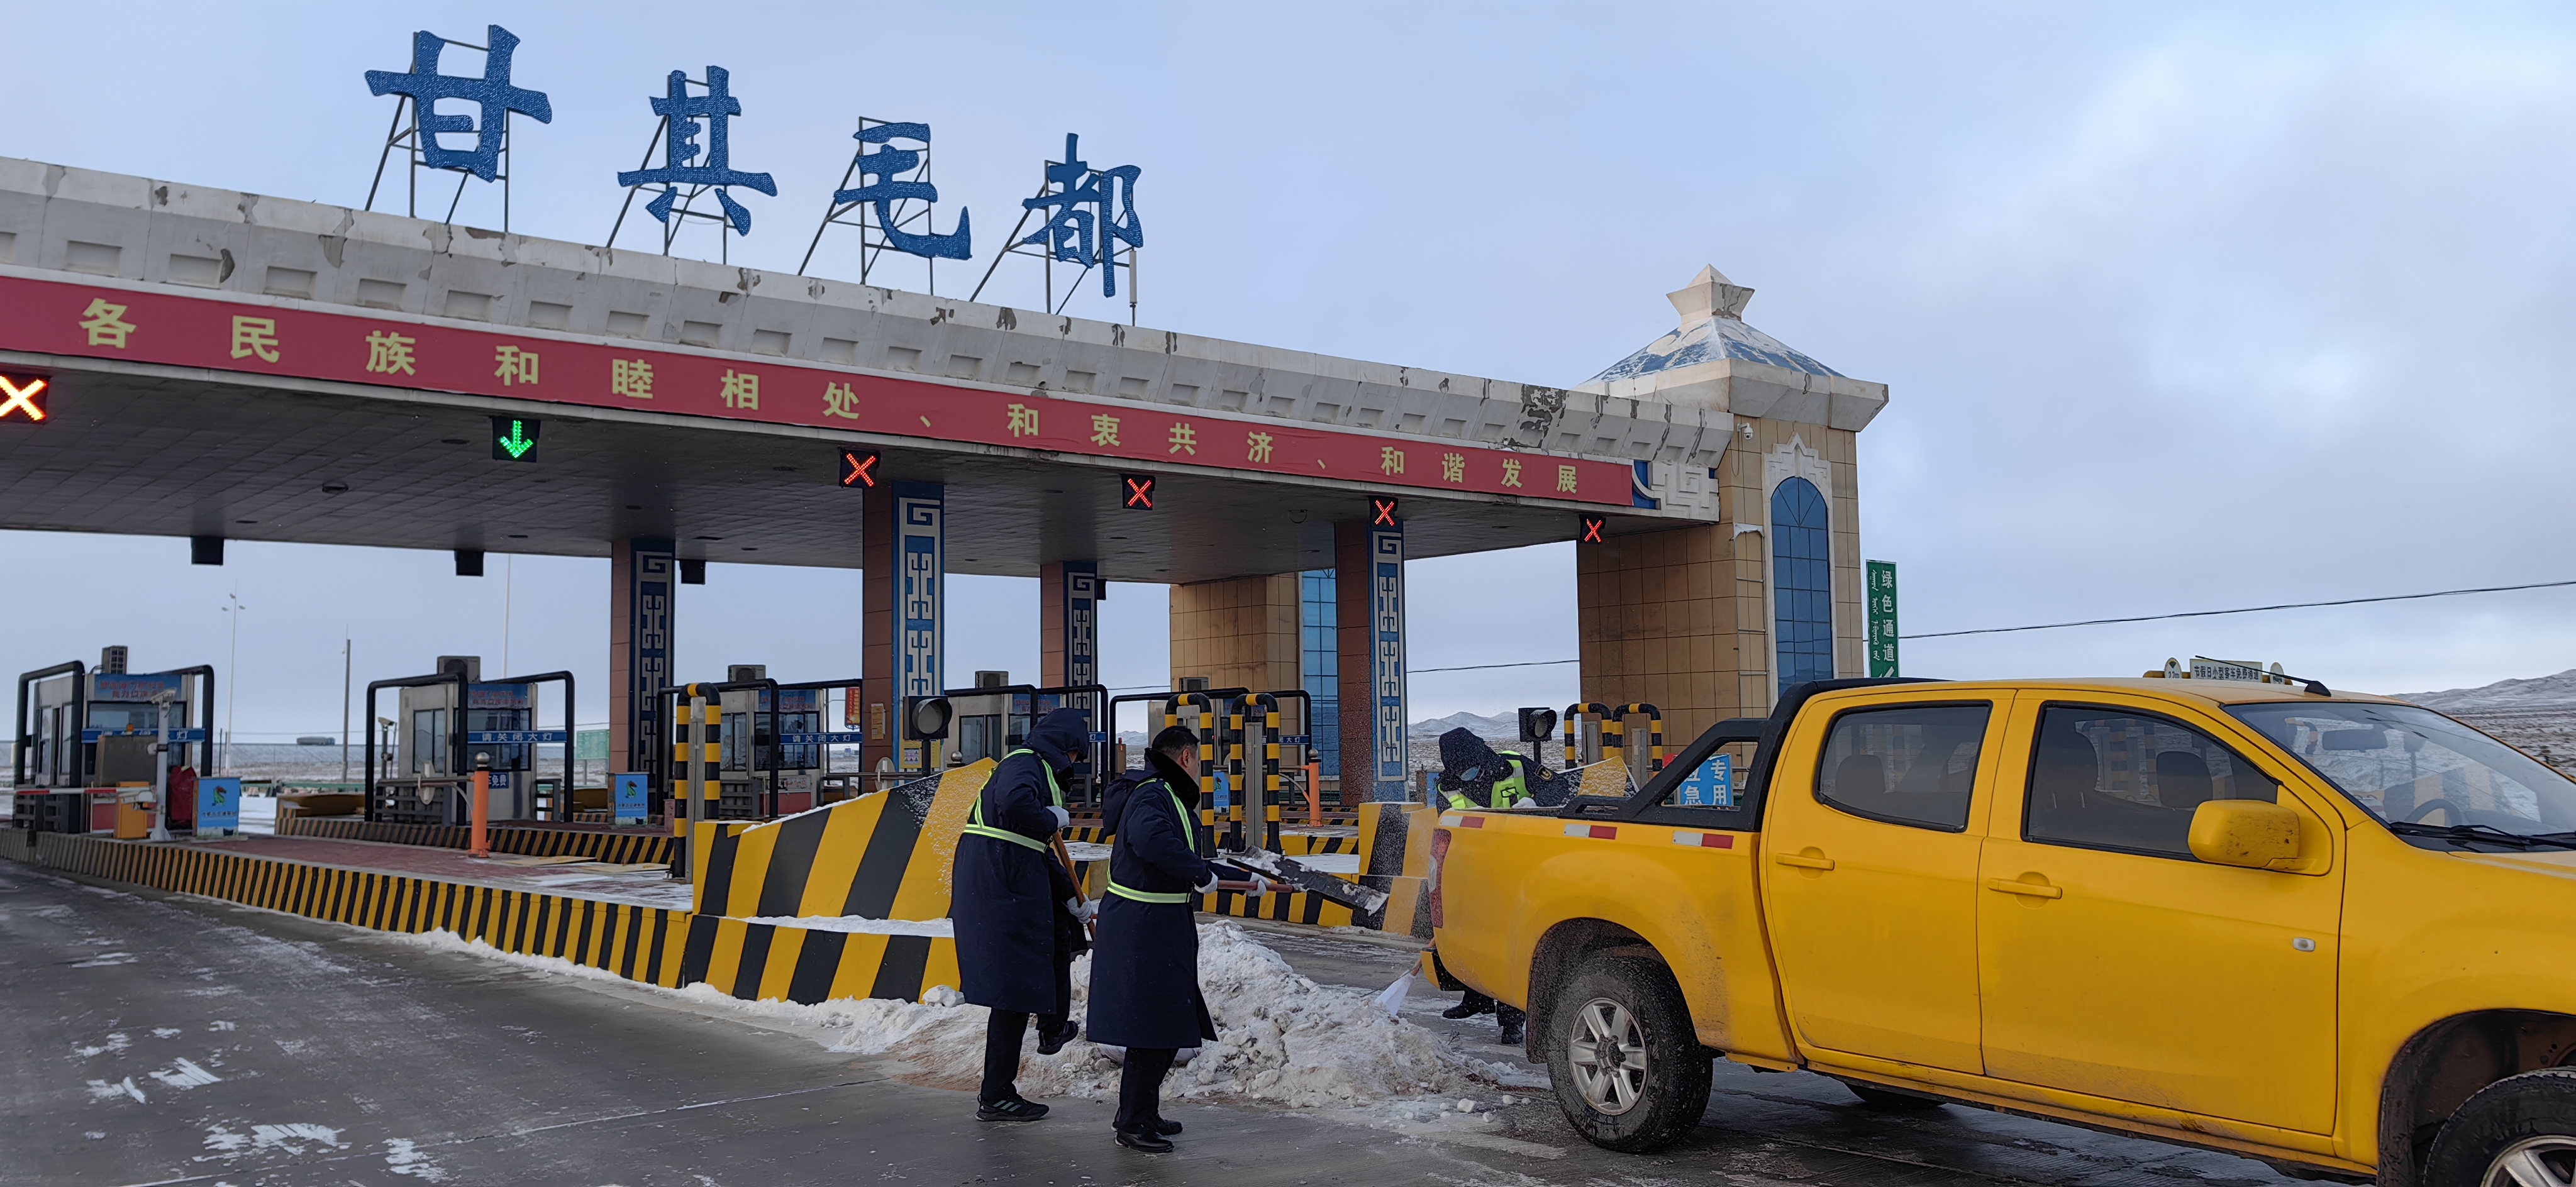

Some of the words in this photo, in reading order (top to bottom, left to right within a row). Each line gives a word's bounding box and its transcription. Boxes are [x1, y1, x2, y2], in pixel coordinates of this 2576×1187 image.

[364, 24, 1143, 298] 甘其毛都
[79, 297, 1577, 495] 各民族和睦相处、和衷共济、和谐发展
[1882, 570, 1895, 661] 绿色通道
[482, 732, 553, 742] 请关闭大灯
[792, 734, 851, 743] 请关闭大灯
[489, 774, 506, 787] 免费
[1710, 759, 1727, 805] 专用
